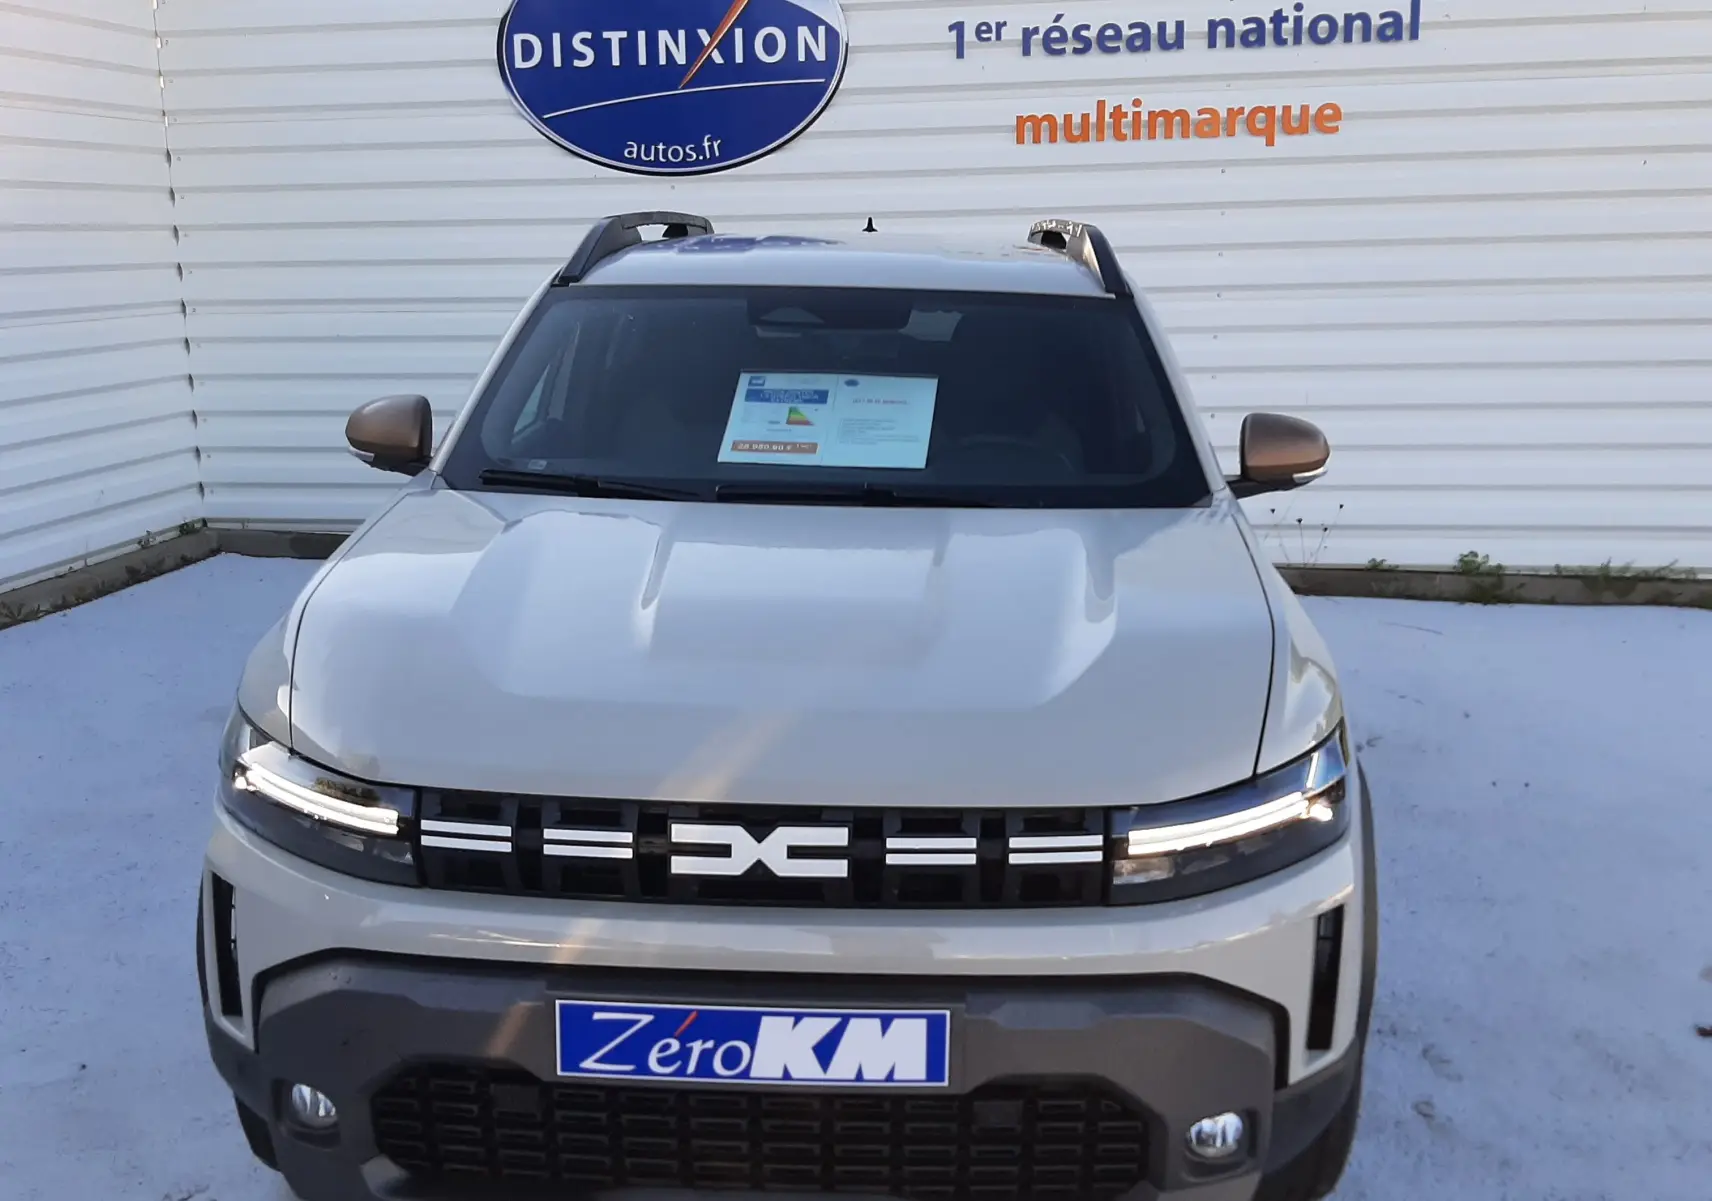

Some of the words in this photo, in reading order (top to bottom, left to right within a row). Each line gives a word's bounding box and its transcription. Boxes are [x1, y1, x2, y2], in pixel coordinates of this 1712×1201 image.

[513, 24, 827, 69] DISTINXION
[947, 18, 1008, 60] 1er
[1022, 13, 1186, 57] réseau
[1207, 0, 1421, 49] national
[1014, 98, 1343, 147] multimarque
[623, 134, 723, 163] autos.fr
